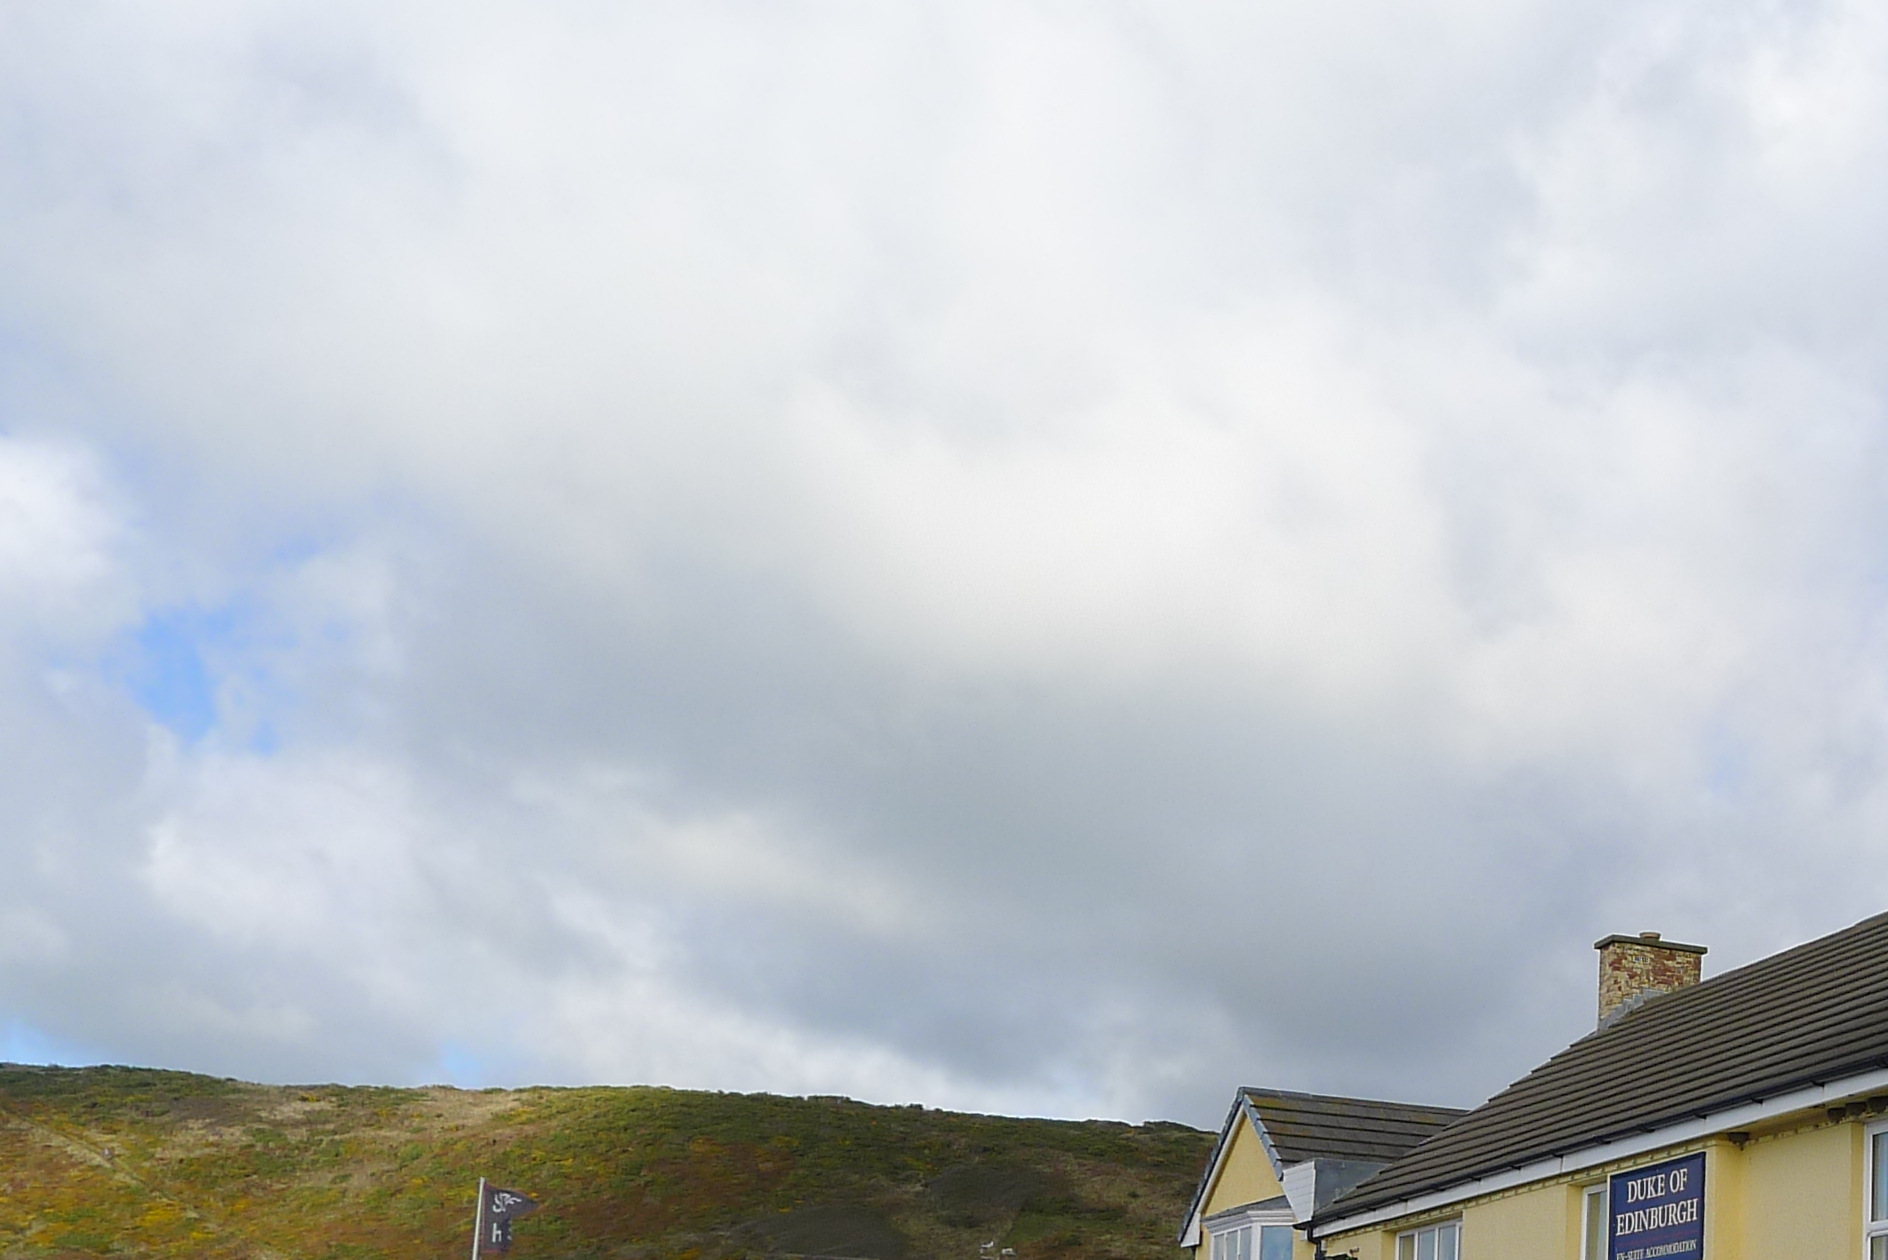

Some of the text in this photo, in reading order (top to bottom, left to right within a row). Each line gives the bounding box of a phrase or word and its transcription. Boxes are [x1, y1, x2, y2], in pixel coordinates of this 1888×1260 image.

[1627, 1168, 1688, 1203] DUKE OF
[1615, 1198, 1699, 1236] EDINBURGH
